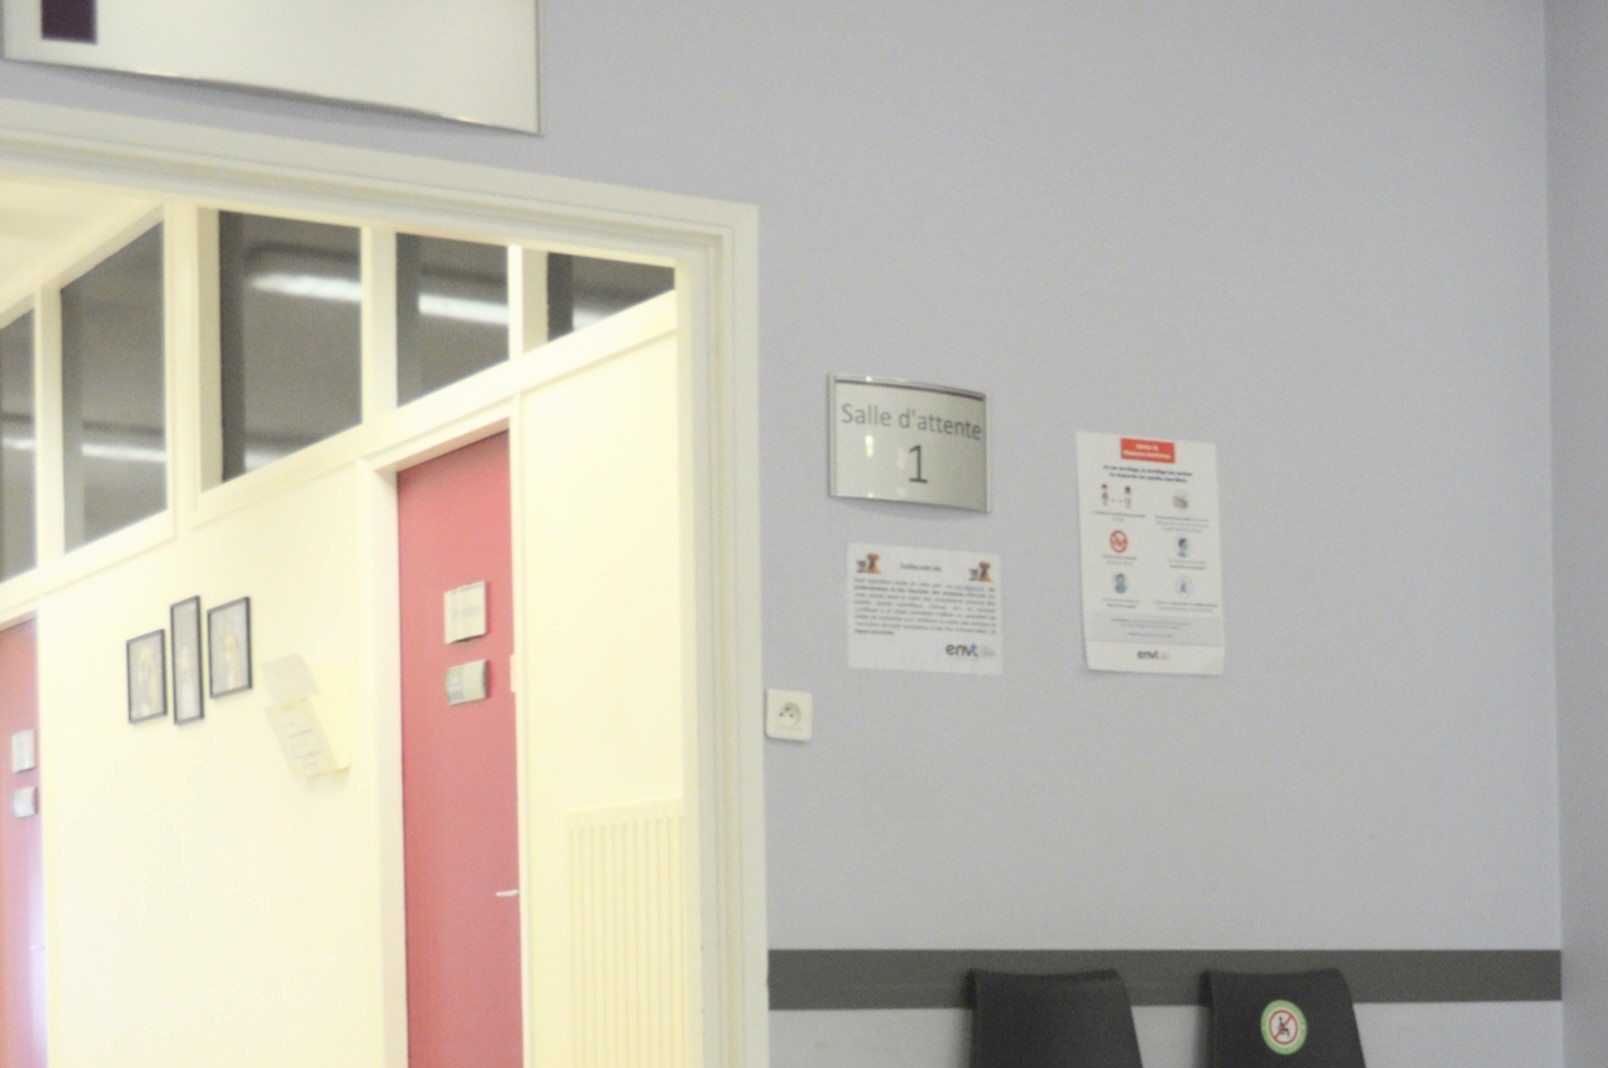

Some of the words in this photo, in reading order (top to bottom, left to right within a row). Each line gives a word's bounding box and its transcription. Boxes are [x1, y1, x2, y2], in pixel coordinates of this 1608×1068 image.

[841, 403, 892, 427] Salle
[898, 407, 981, 440] d'attente
[908, 444, 929, 484] 1
[945, 643, 978, 658] envt
